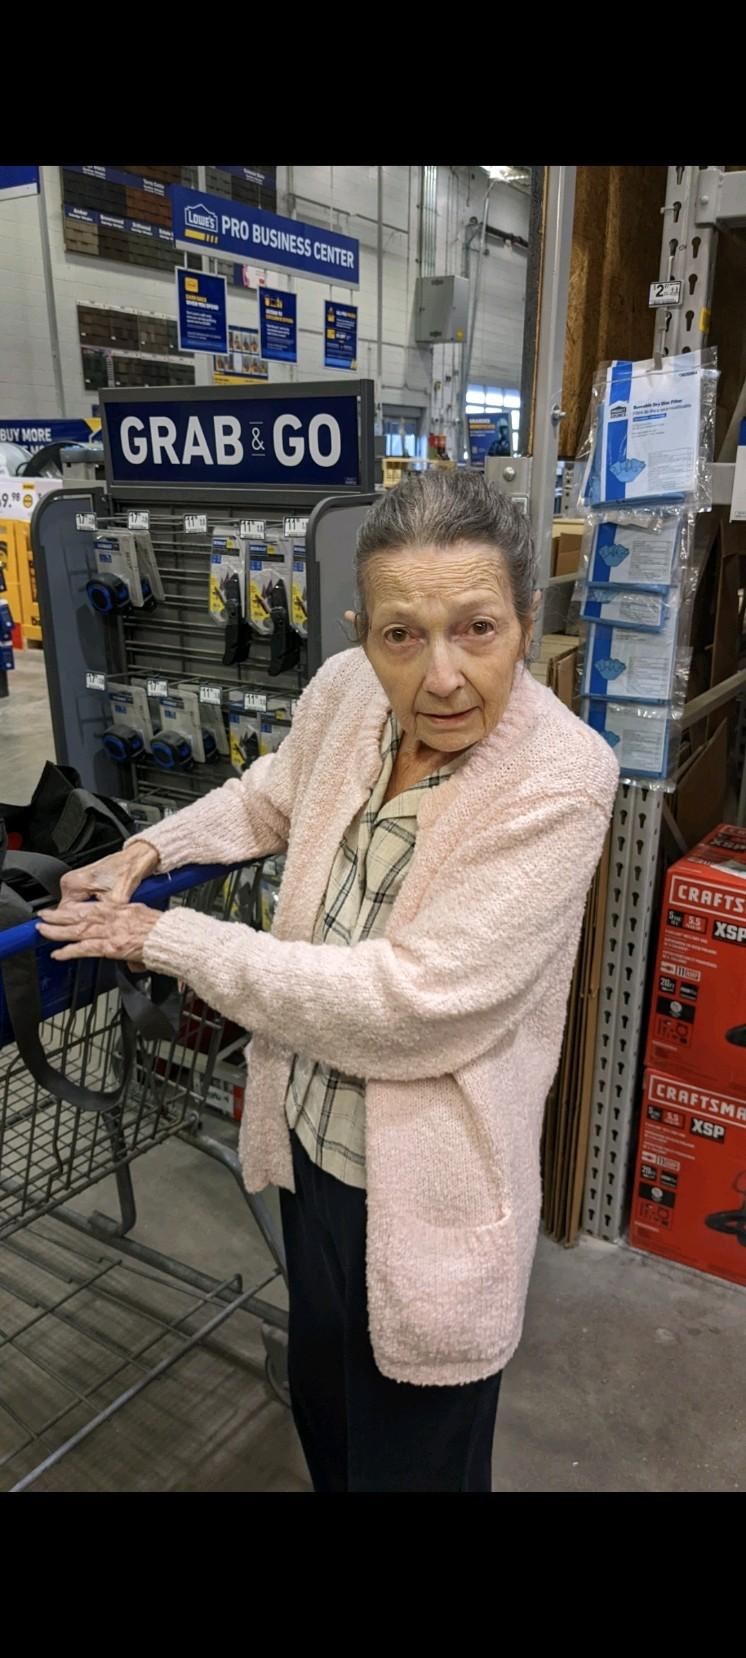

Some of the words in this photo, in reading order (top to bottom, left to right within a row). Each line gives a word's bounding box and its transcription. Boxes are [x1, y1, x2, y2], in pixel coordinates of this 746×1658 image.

[222, 215, 249, 241] PRO
[253, 223, 311, 258] BUSINESS
[313, 241, 354, 270] CENTER
[0, 428, 20, 442] BUY
[22, 427, 53, 442] MORE
[120, 415, 244, 466] GRAB
[251, 426, 266, 451] &
[272, 413, 342, 468] GO
[714, 921, 746, 943] XSP
[691, 1118, 725, 1140] XSP
